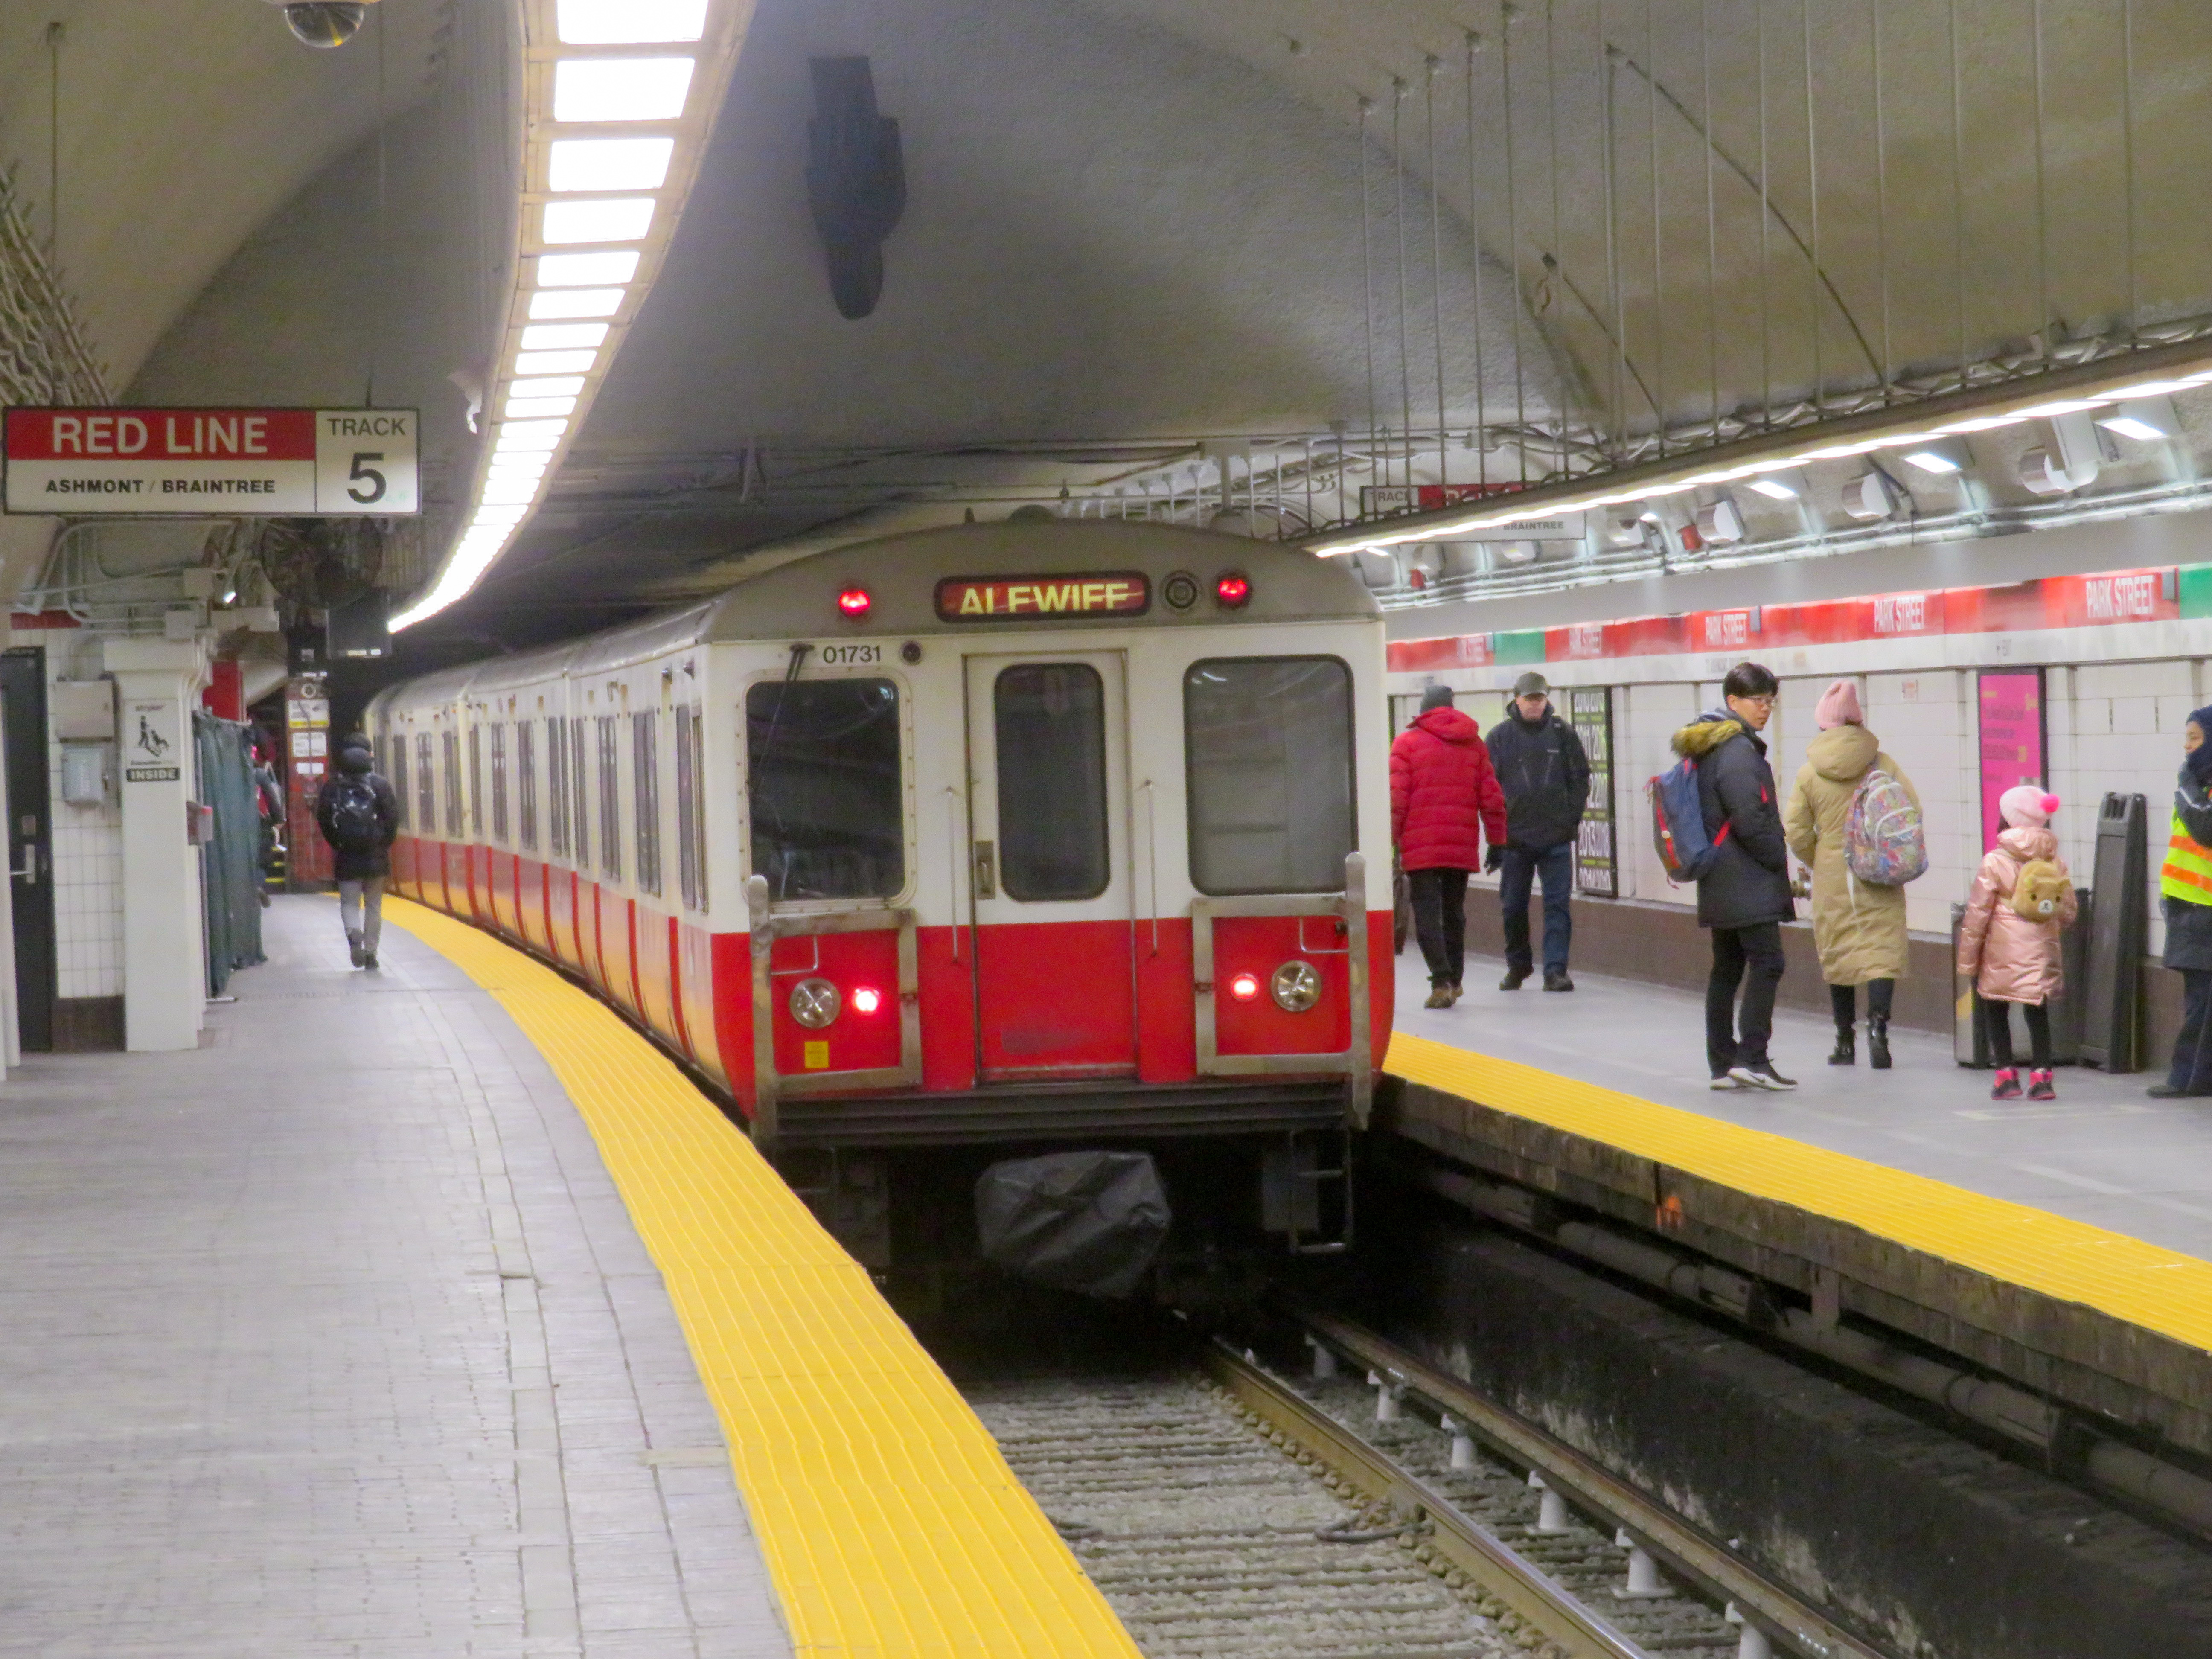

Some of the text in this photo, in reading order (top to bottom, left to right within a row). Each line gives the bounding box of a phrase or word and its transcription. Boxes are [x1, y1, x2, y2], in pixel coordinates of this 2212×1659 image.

[52, 416, 268, 454] RED LINE
[326, 416, 407, 437] TRACK
[45, 479, 143, 494] ASHMONT
[162, 479, 276, 494] BRAINTREE
[346, 451, 387, 505] 5
[2086, 574, 2155, 618] PARK STREET
[1896, 594, 1925, 632] STREET
[823, 645, 881, 664] 01731
[131, 770, 176, 780] INSIDE
